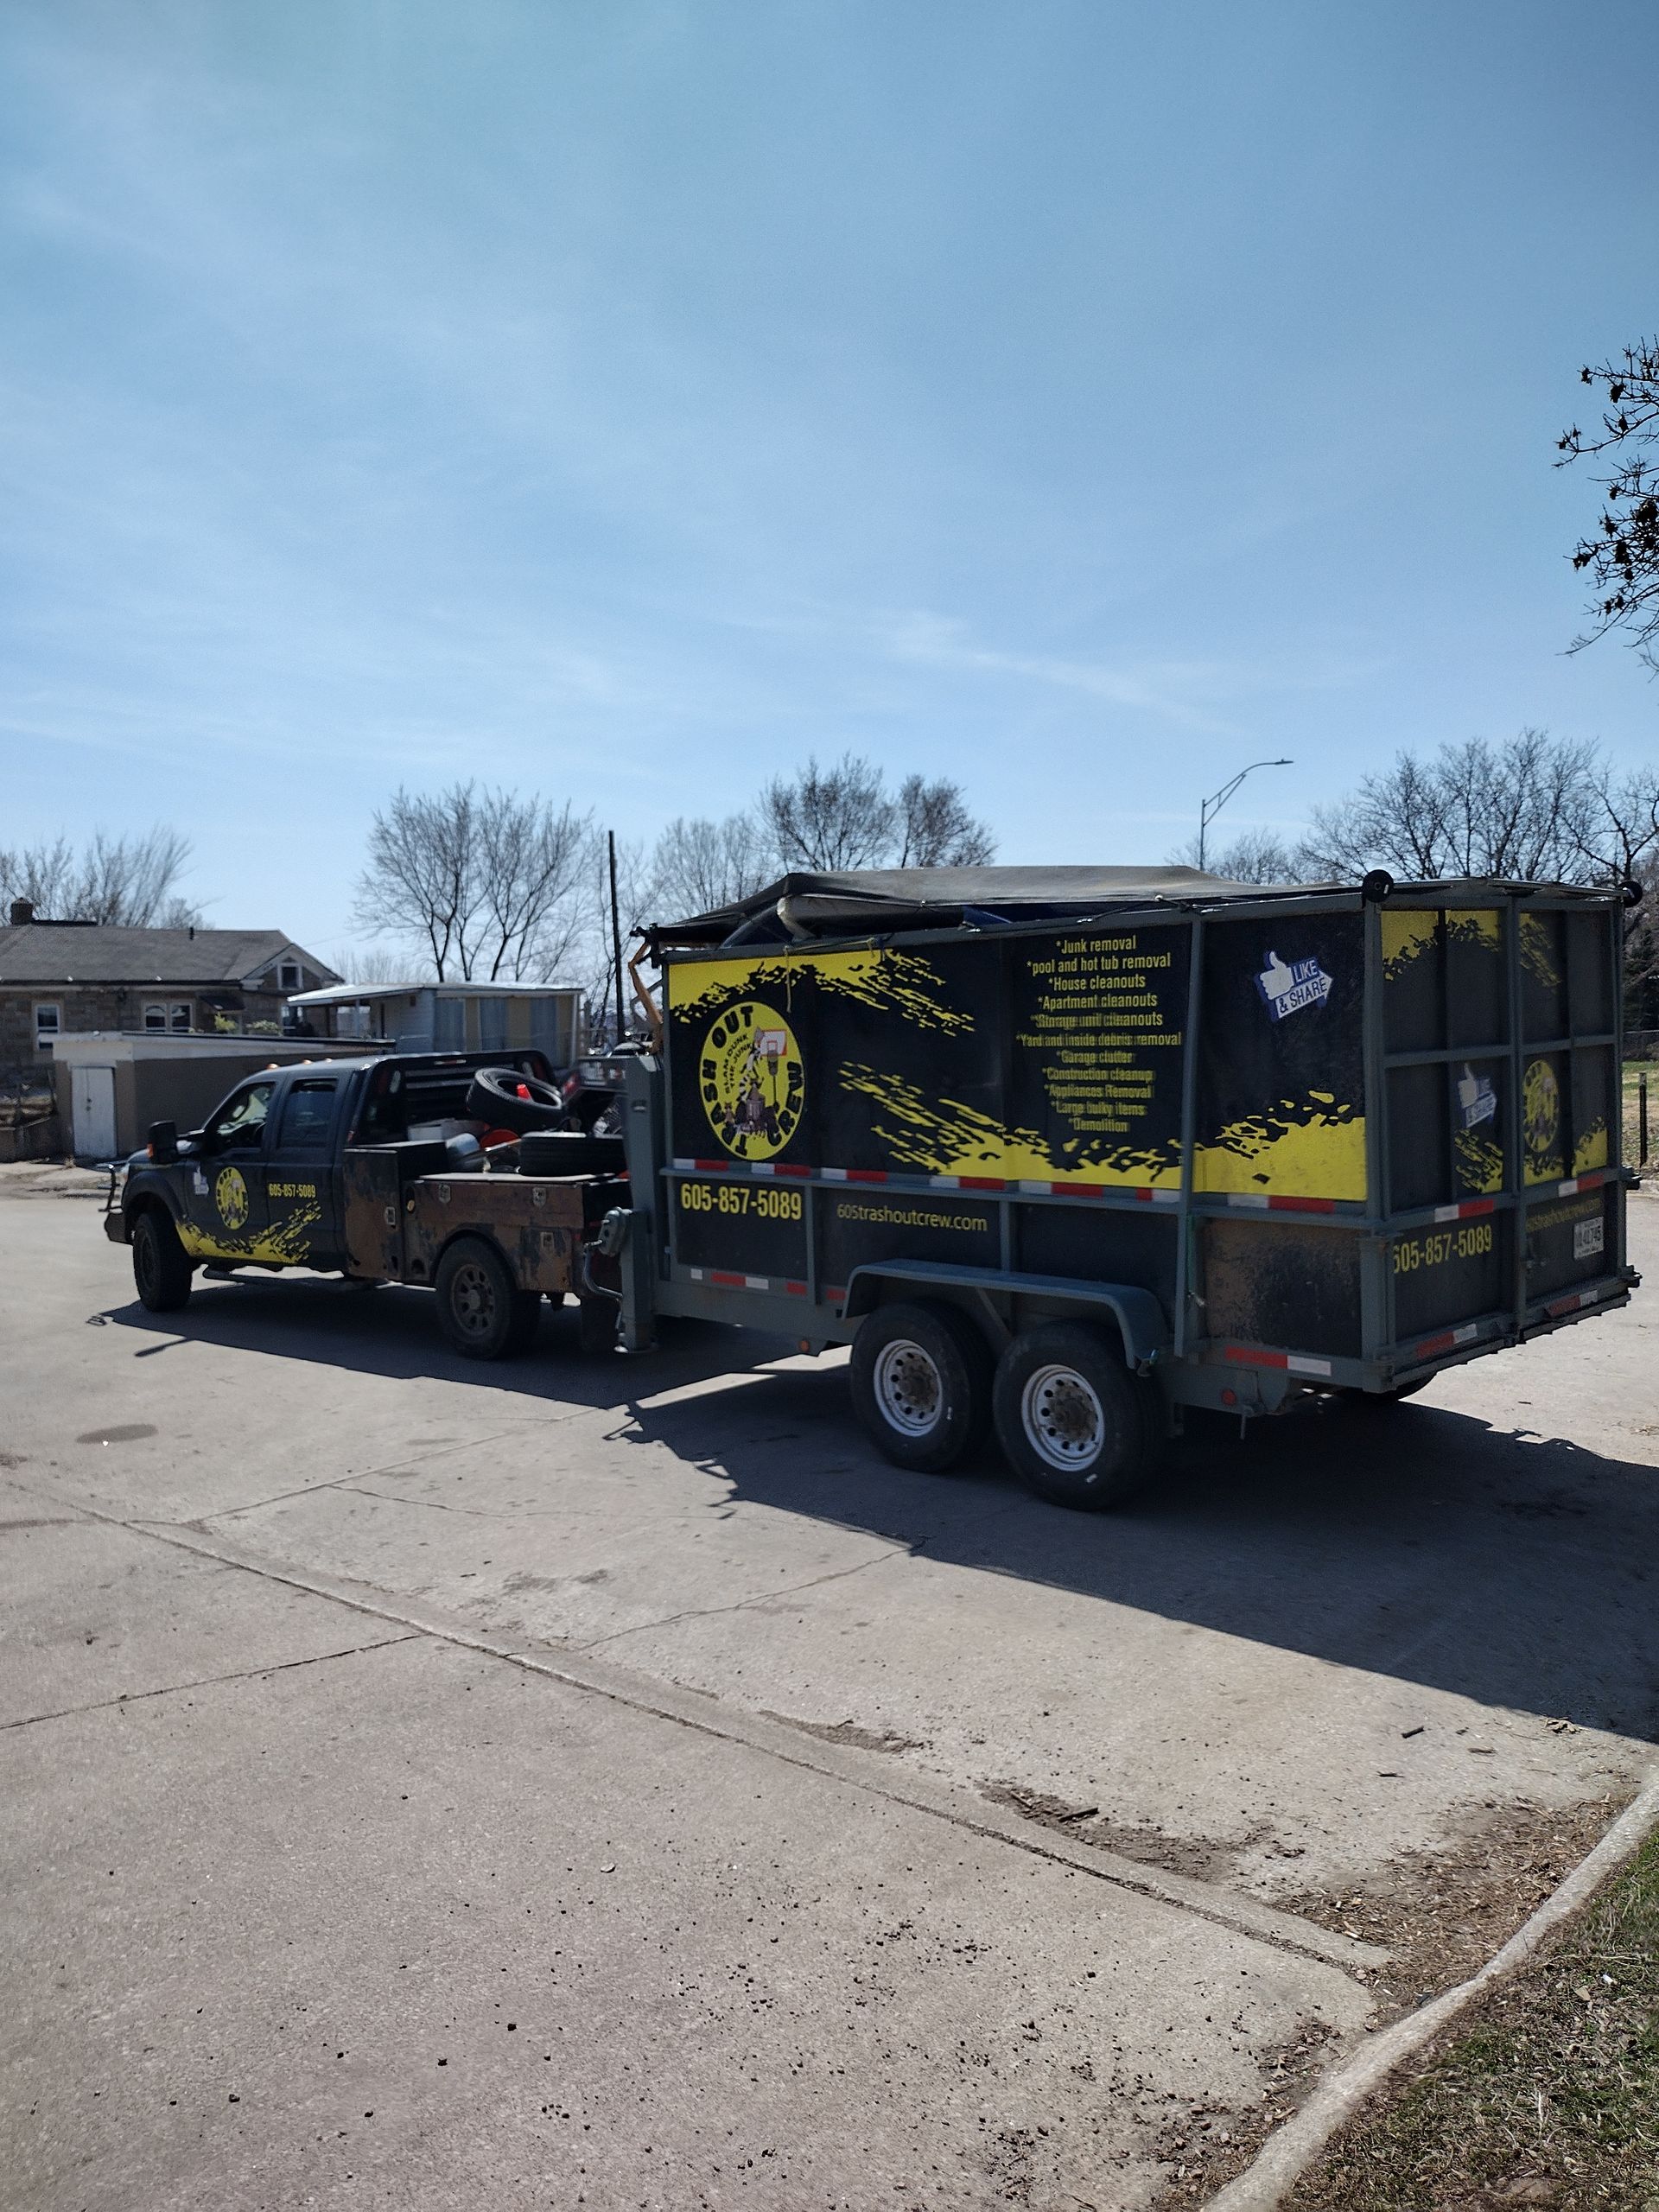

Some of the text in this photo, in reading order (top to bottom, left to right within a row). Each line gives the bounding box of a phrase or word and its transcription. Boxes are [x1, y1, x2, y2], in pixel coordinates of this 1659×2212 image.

[1090, 934, 1137, 952] removal
[1058, 957, 1077, 973] and
[1080, 955, 1098, 971] hot
[1101, 954, 1119, 969] tub
[1122, 951, 1172, 969] removal
[1293, 959, 1319, 983] LIKE
[1090, 973, 1146, 990] cleanouts
[1101, 992, 1158, 1008] cleanouts
[1279, 977, 1328, 1014] & SHARE
[1103, 1011, 1164, 1027] cleanouts
[1044, 1033, 1063, 1047] and
[1134, 1031, 1182, 1046] removal
[711, 1005, 754, 1049] OUT
[767, 1060, 804, 1147] CREW
[268, 1183, 316, 1198] 605-857-5089
[681, 1183, 803, 1221] 605-857-5089
[836, 1203, 988, 1232] 605trashoutcrew.com
